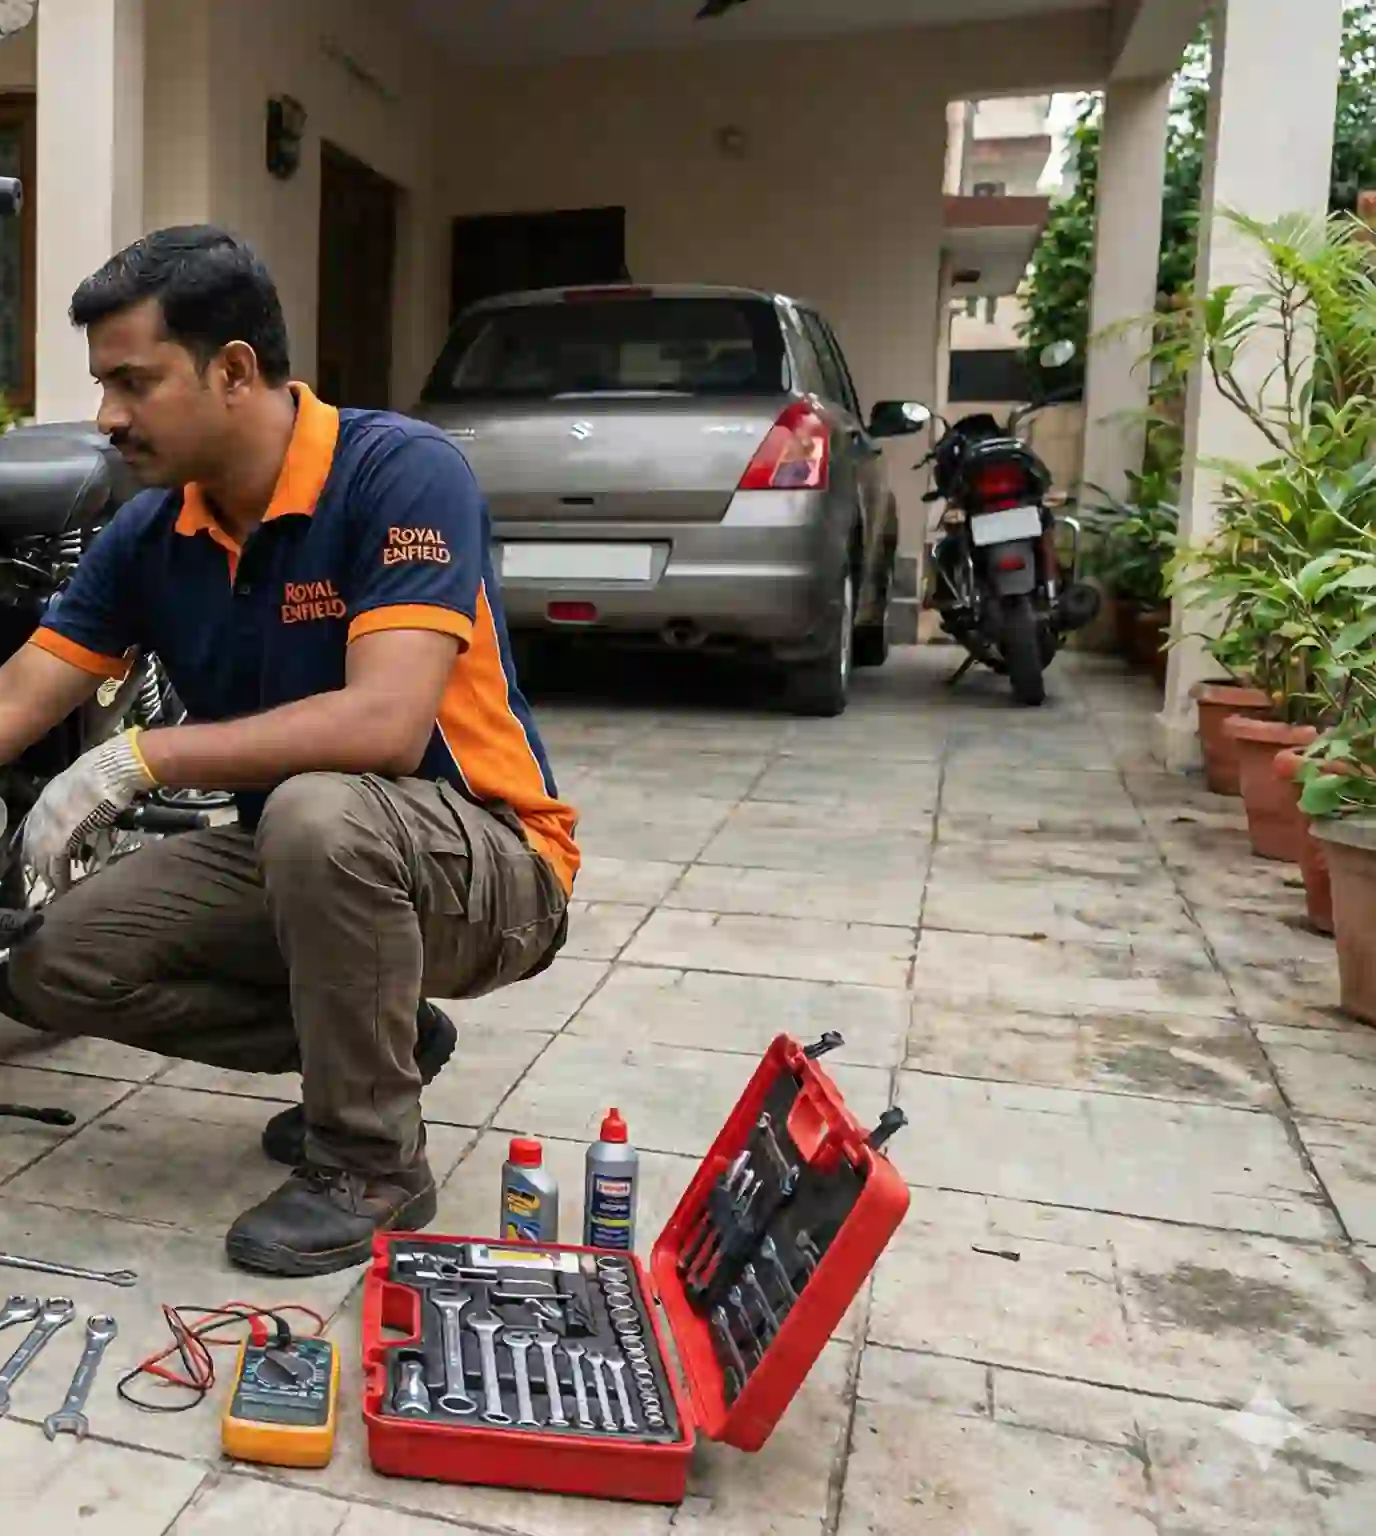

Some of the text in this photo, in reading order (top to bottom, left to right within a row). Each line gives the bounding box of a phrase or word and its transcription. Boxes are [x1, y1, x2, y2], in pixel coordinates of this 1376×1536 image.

[388, 527, 446, 545] ROYAL
[383, 546, 451, 565] ENFIELD
[284, 580, 339, 603] ROYAL
[281, 599, 347, 624] ENFIELD
